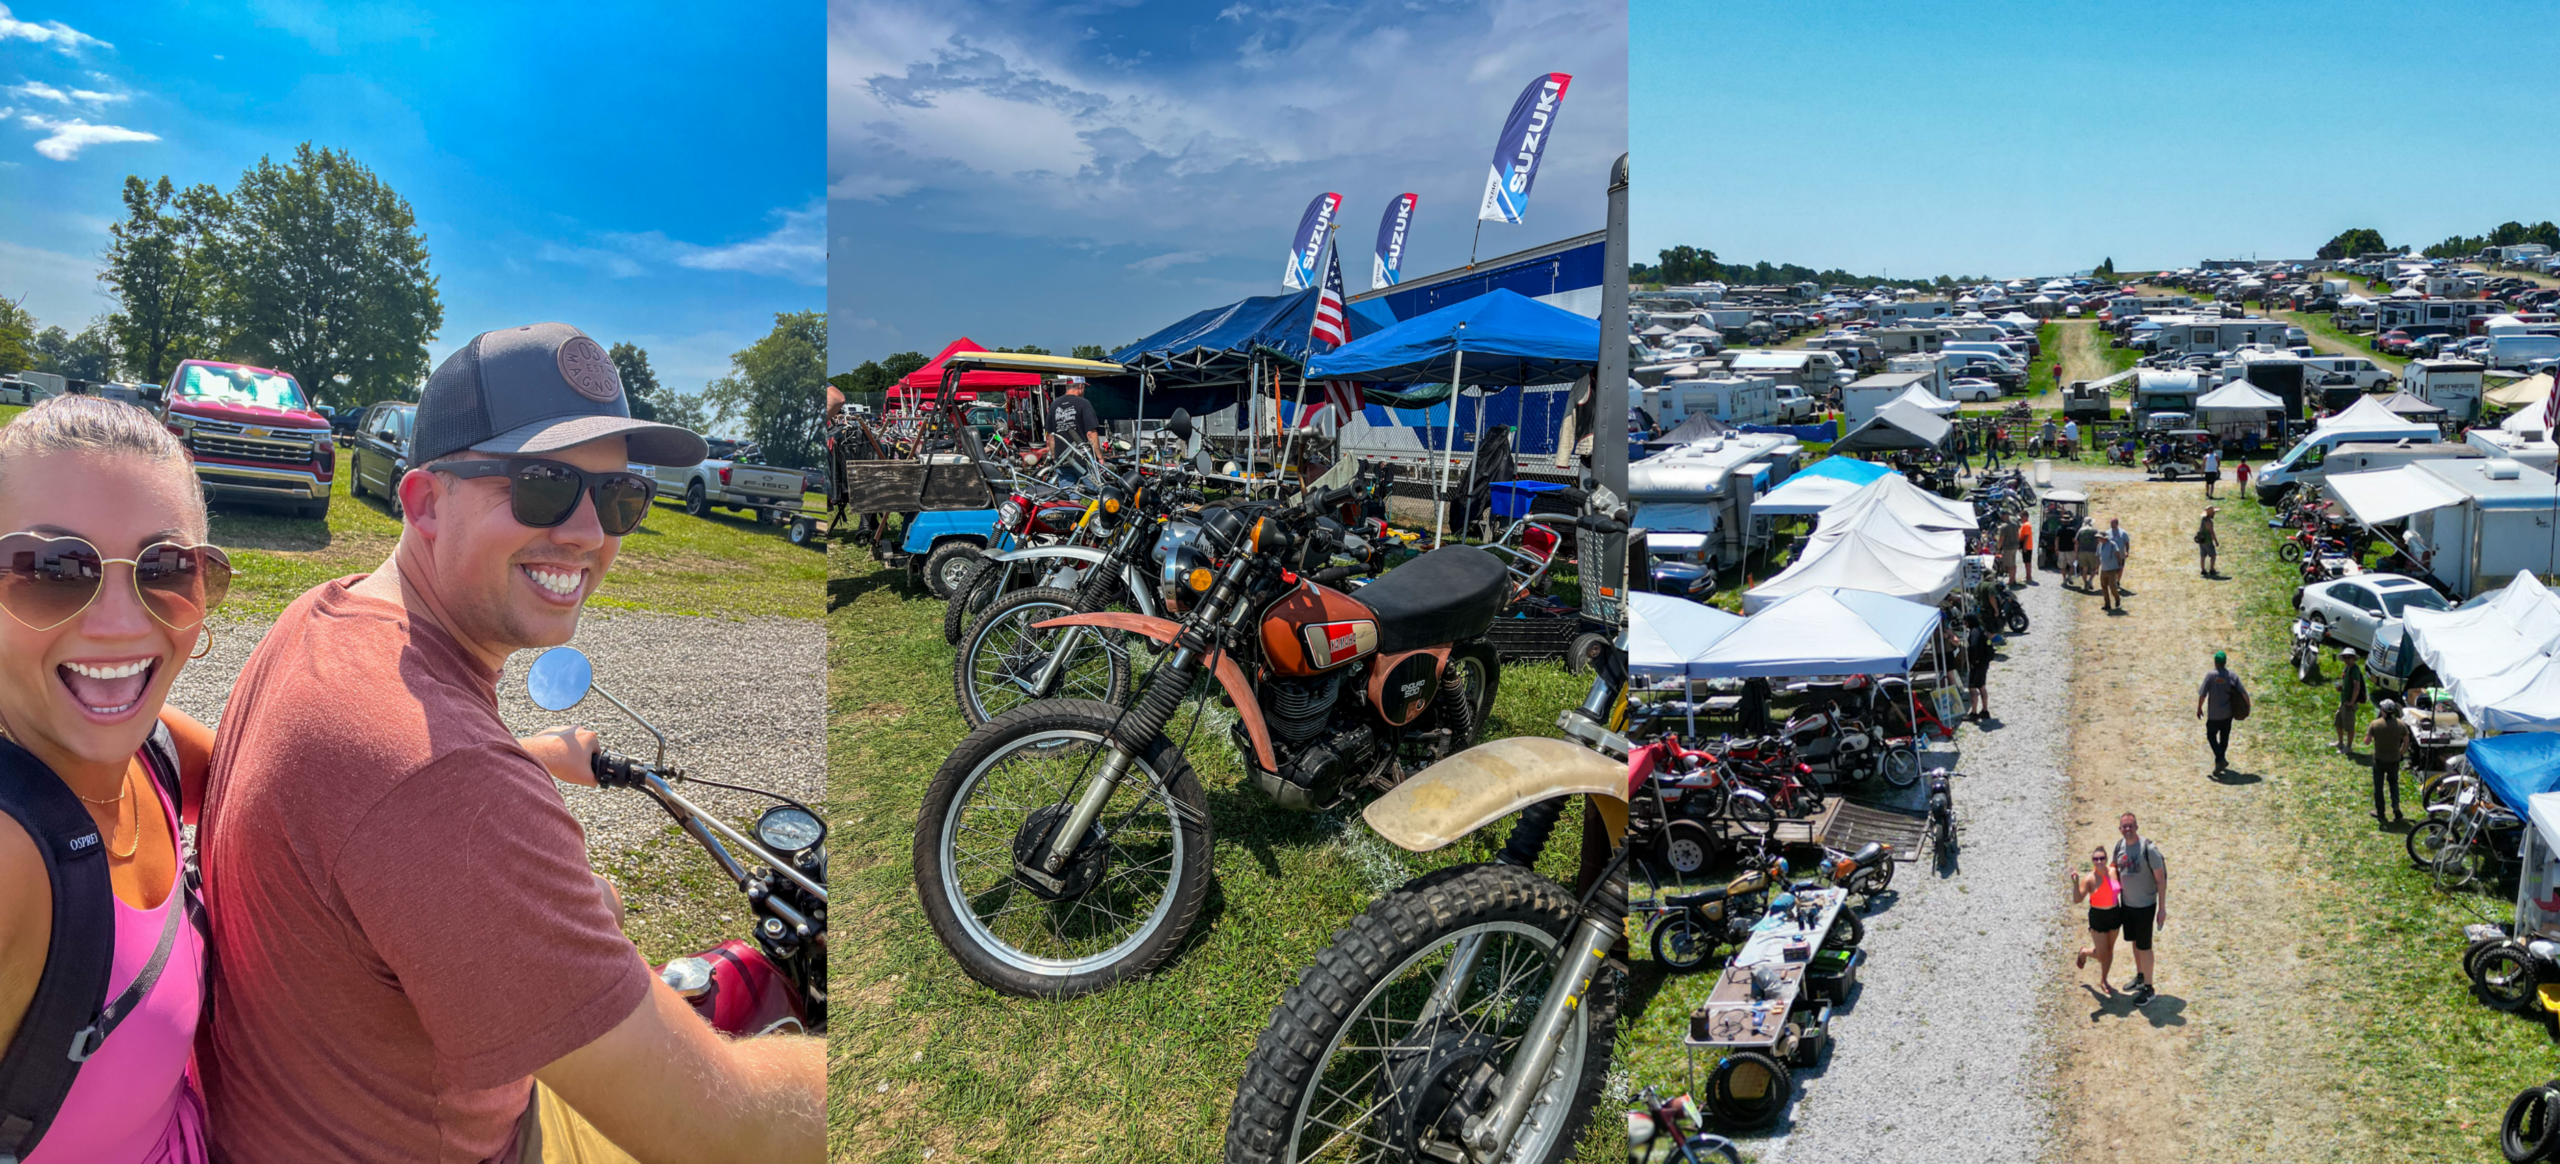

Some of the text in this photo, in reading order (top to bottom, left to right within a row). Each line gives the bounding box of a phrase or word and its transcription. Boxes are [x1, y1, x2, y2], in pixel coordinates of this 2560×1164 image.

[1509, 80, 1561, 194] SUZUKI
[1302, 196, 1337, 270] SUZUKI
[1388, 198, 1413, 271] SUZUKI
[578, 342, 601, 362] 03
[566, 352, 617, 393] MAGNOLIA
[586, 363, 605, 374] EST
[743, 480, 790, 490] F-150
[1330, 632, 1357, 653] YAMAHA
[1400, 679, 1426, 692] ENDURO
[1403, 686, 1420, 699] 500
